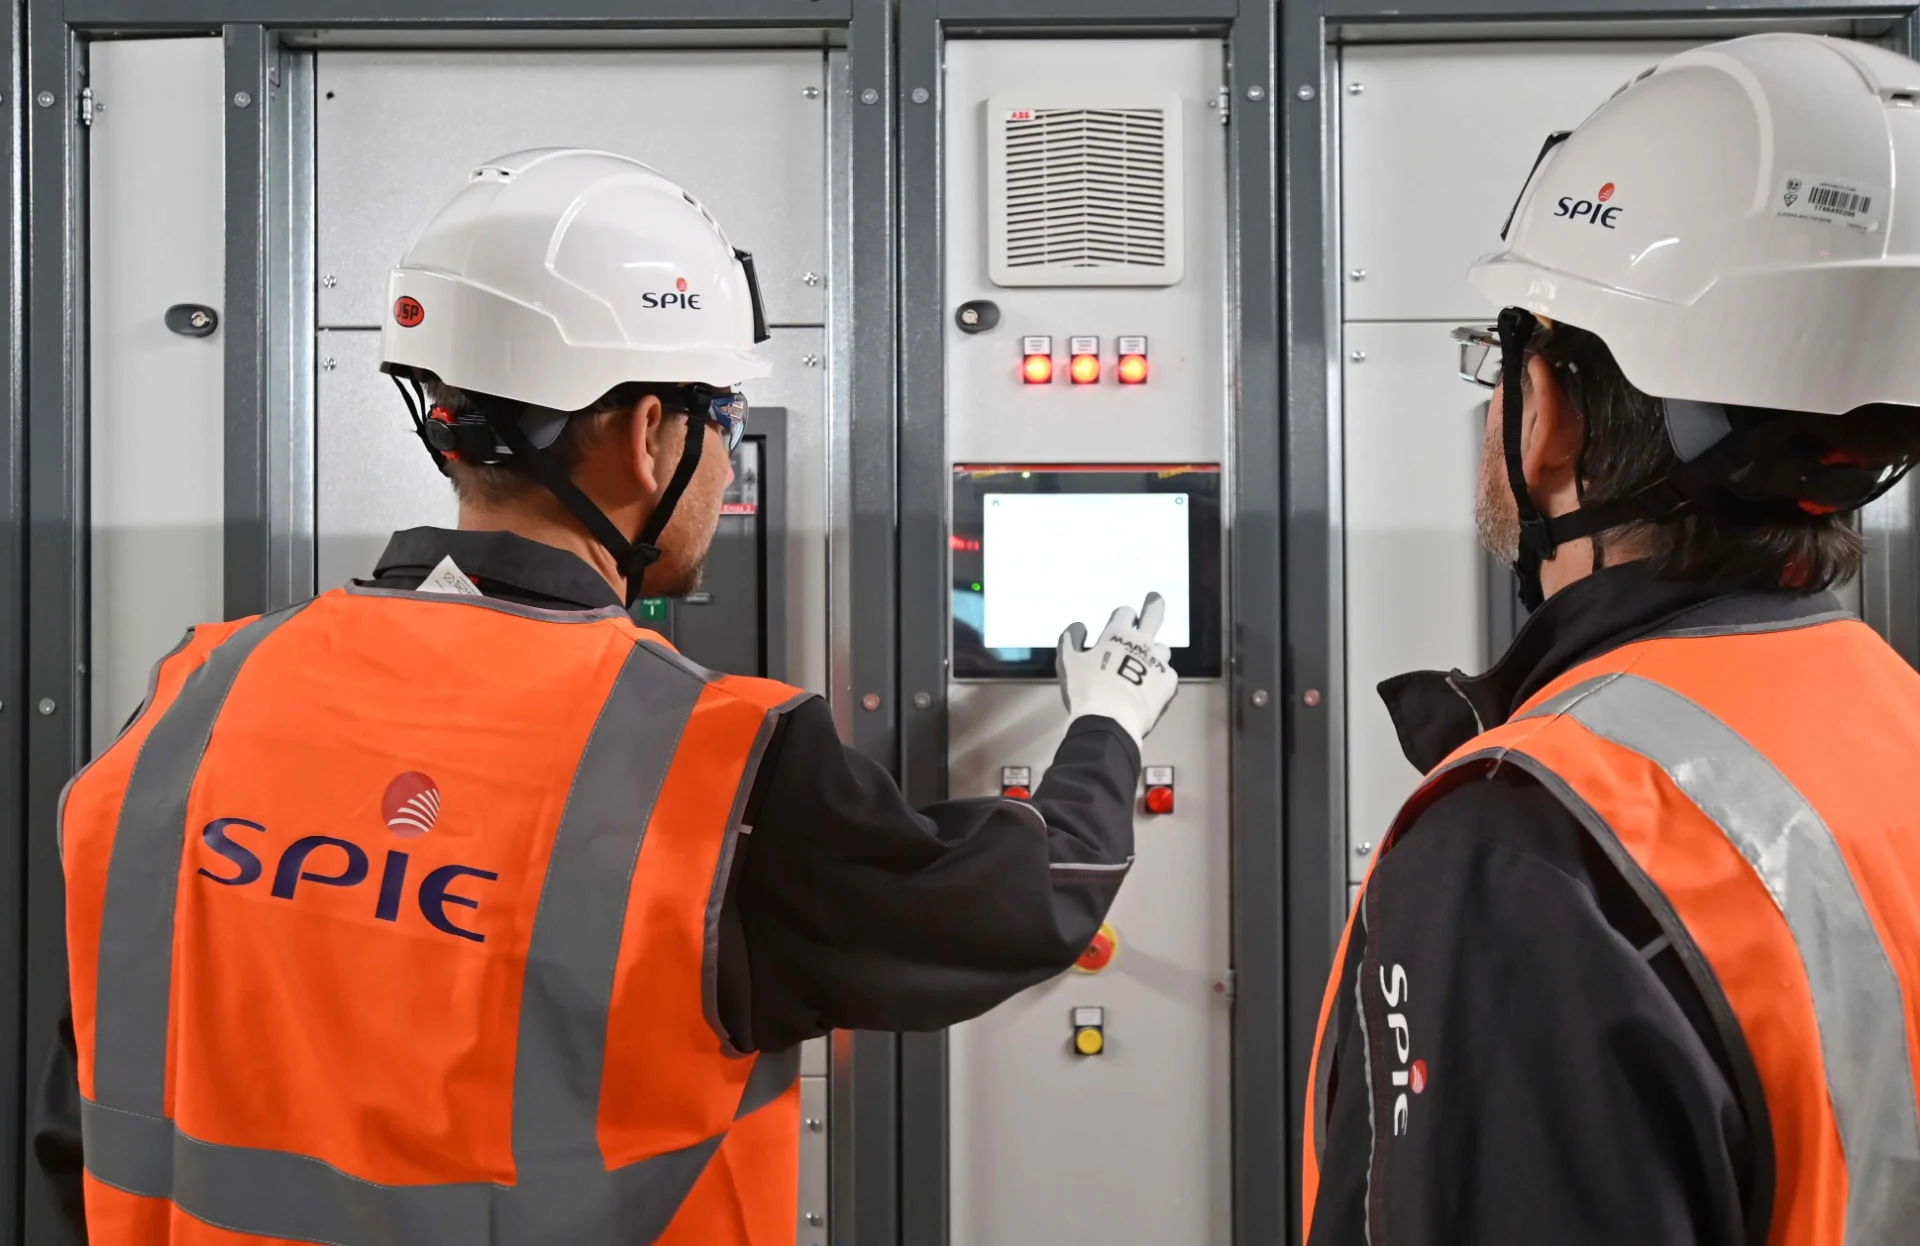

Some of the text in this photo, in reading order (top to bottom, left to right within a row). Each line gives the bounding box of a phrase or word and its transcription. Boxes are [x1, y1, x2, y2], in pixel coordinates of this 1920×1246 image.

[1554, 196, 1624, 230] SPIE
[641, 291, 702, 310] SPIE
[1117, 654, 1147, 686] B
[197, 817, 499, 944] SPIE
[1379, 963, 1410, 1137] SPIE
